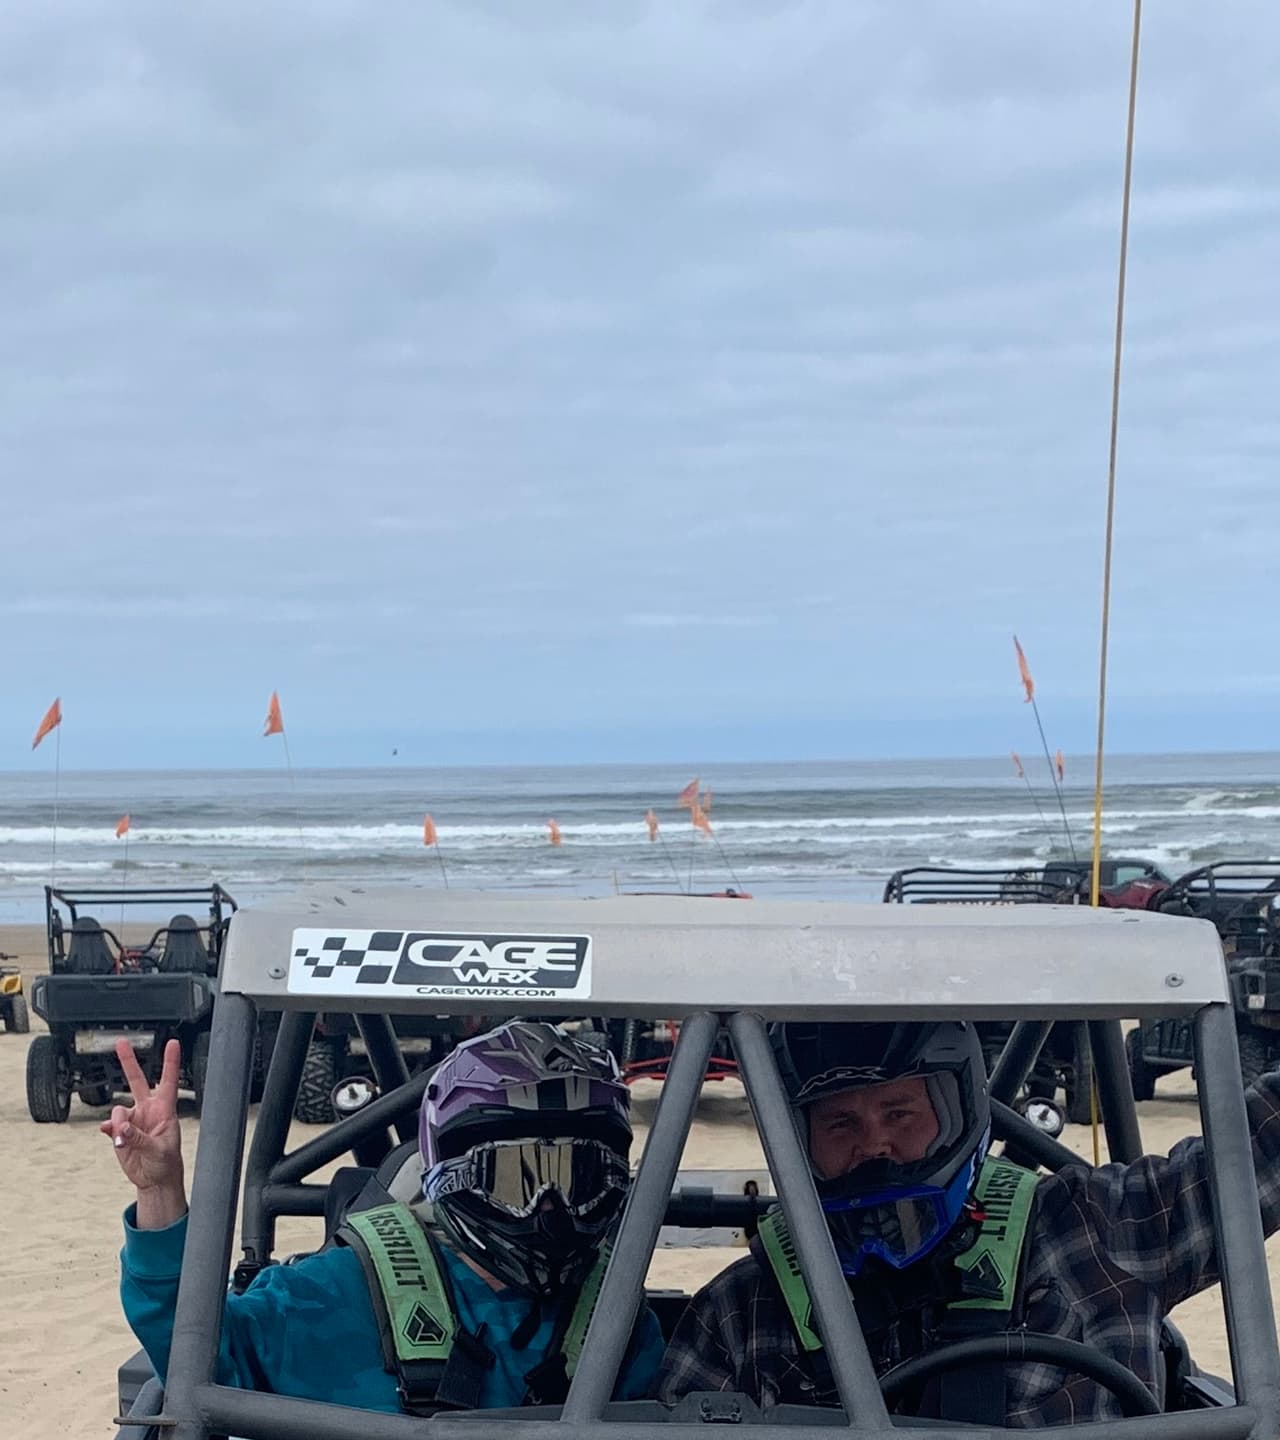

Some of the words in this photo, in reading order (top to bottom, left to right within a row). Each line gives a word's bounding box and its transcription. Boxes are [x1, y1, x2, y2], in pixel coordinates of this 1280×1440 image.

[407, 939, 578, 971] CAGE
[416, 986, 557, 998] CAGEWRX.COM
[452, 967, 538, 985] WRX
[983, 1165, 1026, 1241] ASSAULT
[368, 1209, 429, 1291] ASSAULT
